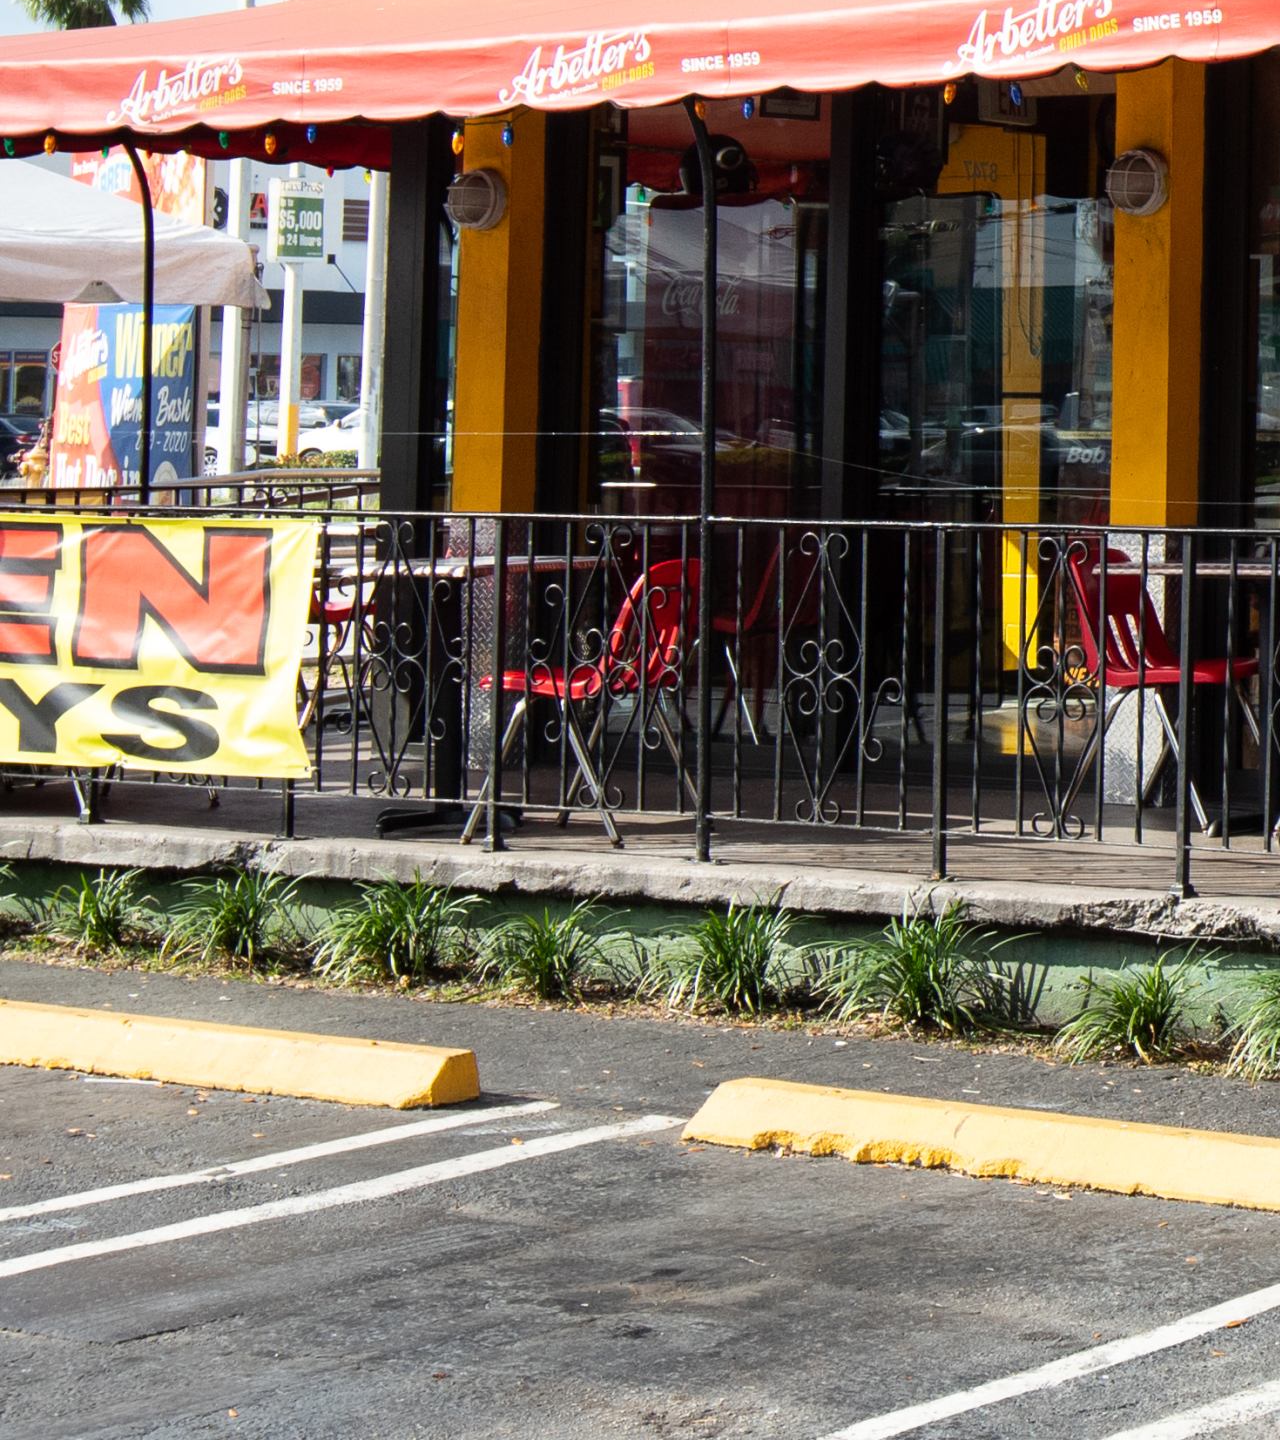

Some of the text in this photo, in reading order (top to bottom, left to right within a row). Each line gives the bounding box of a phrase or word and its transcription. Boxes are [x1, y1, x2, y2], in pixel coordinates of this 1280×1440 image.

[1133, 8, 1223, 32] SINCE 1959
[1059, 18, 1119, 53] CHILI DOGS
[499, 31, 651, 104] Arbetter's
[681, 51, 761, 72] SINCE 1959
[272, 77, 343, 95] SINCE 1959
[601, 62, 655, 91] CHILI DOGS
[106, 57, 243, 126] Arbetter's
[279, 209, 322, 233] $5,000
[286, 233, 298, 247] 24
[155, 384, 192, 427] Bash
[57, 400, 92, 447] Best
[162, 430, 188, 453] 2020
[1066, 444, 1106, 464] Bob
[0, 678, 221, 763] YS
